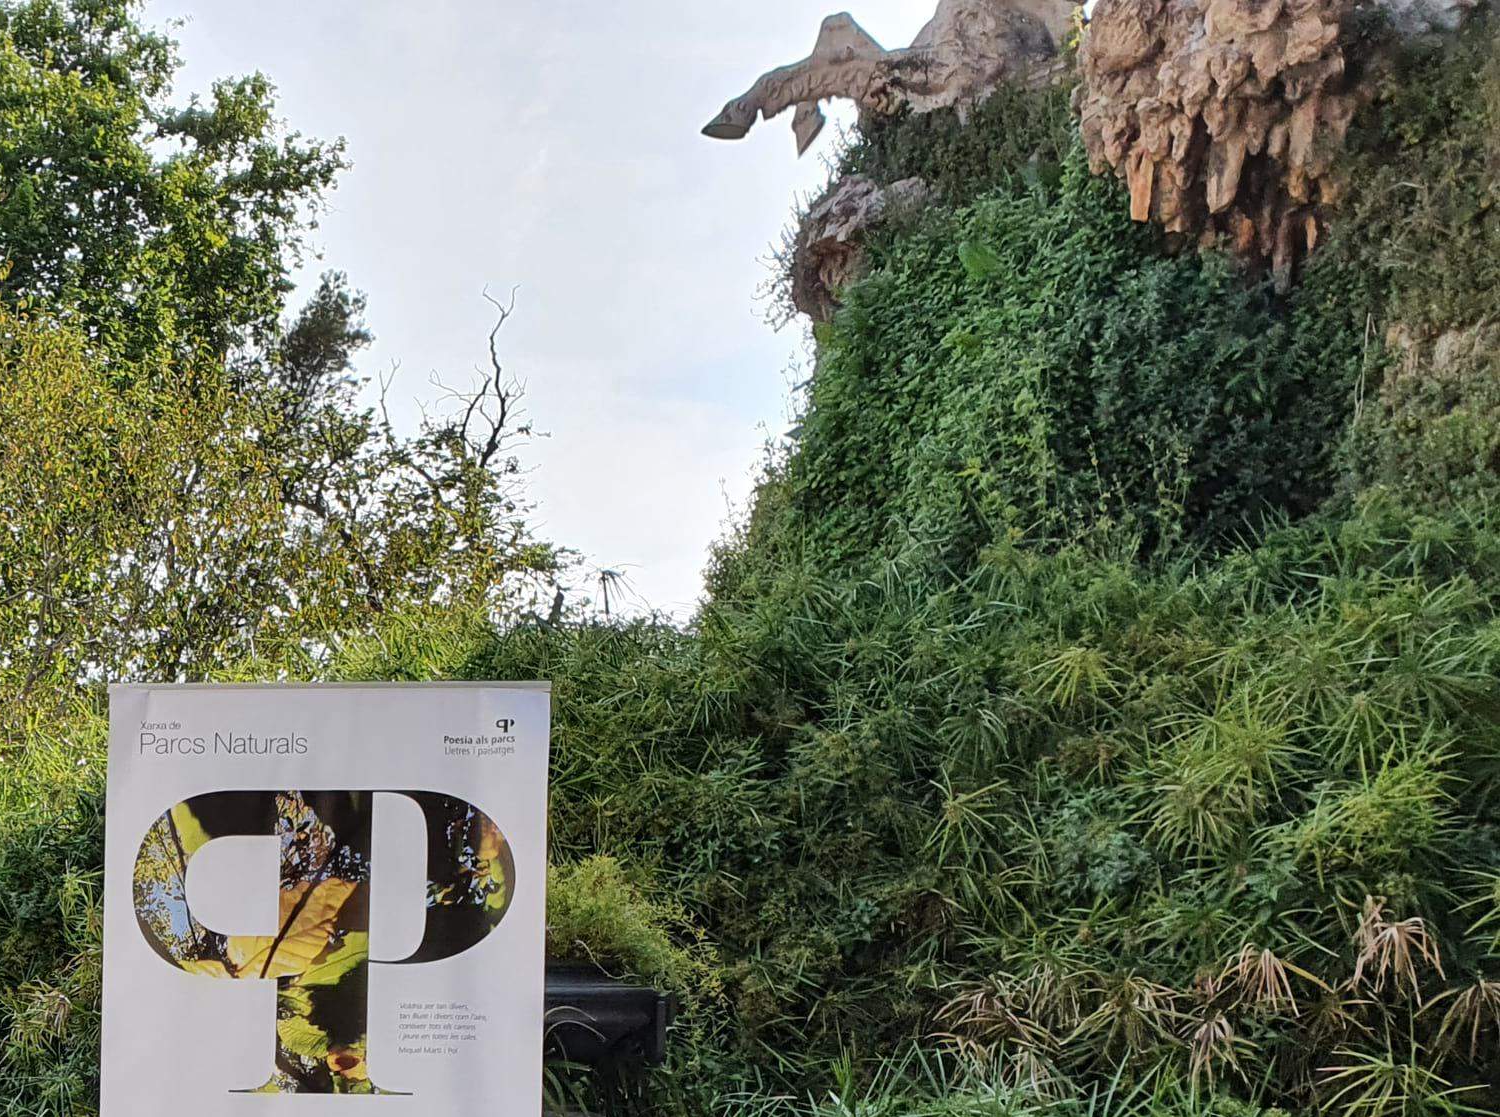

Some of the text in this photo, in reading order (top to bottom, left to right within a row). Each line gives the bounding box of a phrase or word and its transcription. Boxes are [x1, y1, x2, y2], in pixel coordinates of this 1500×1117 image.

[140, 720, 182, 730] Xarxa de
[140, 731, 308, 755] Parcs Naturals
[443, 735, 516, 746] Poesia als parcs
[444, 746, 471, 756] Lletres
